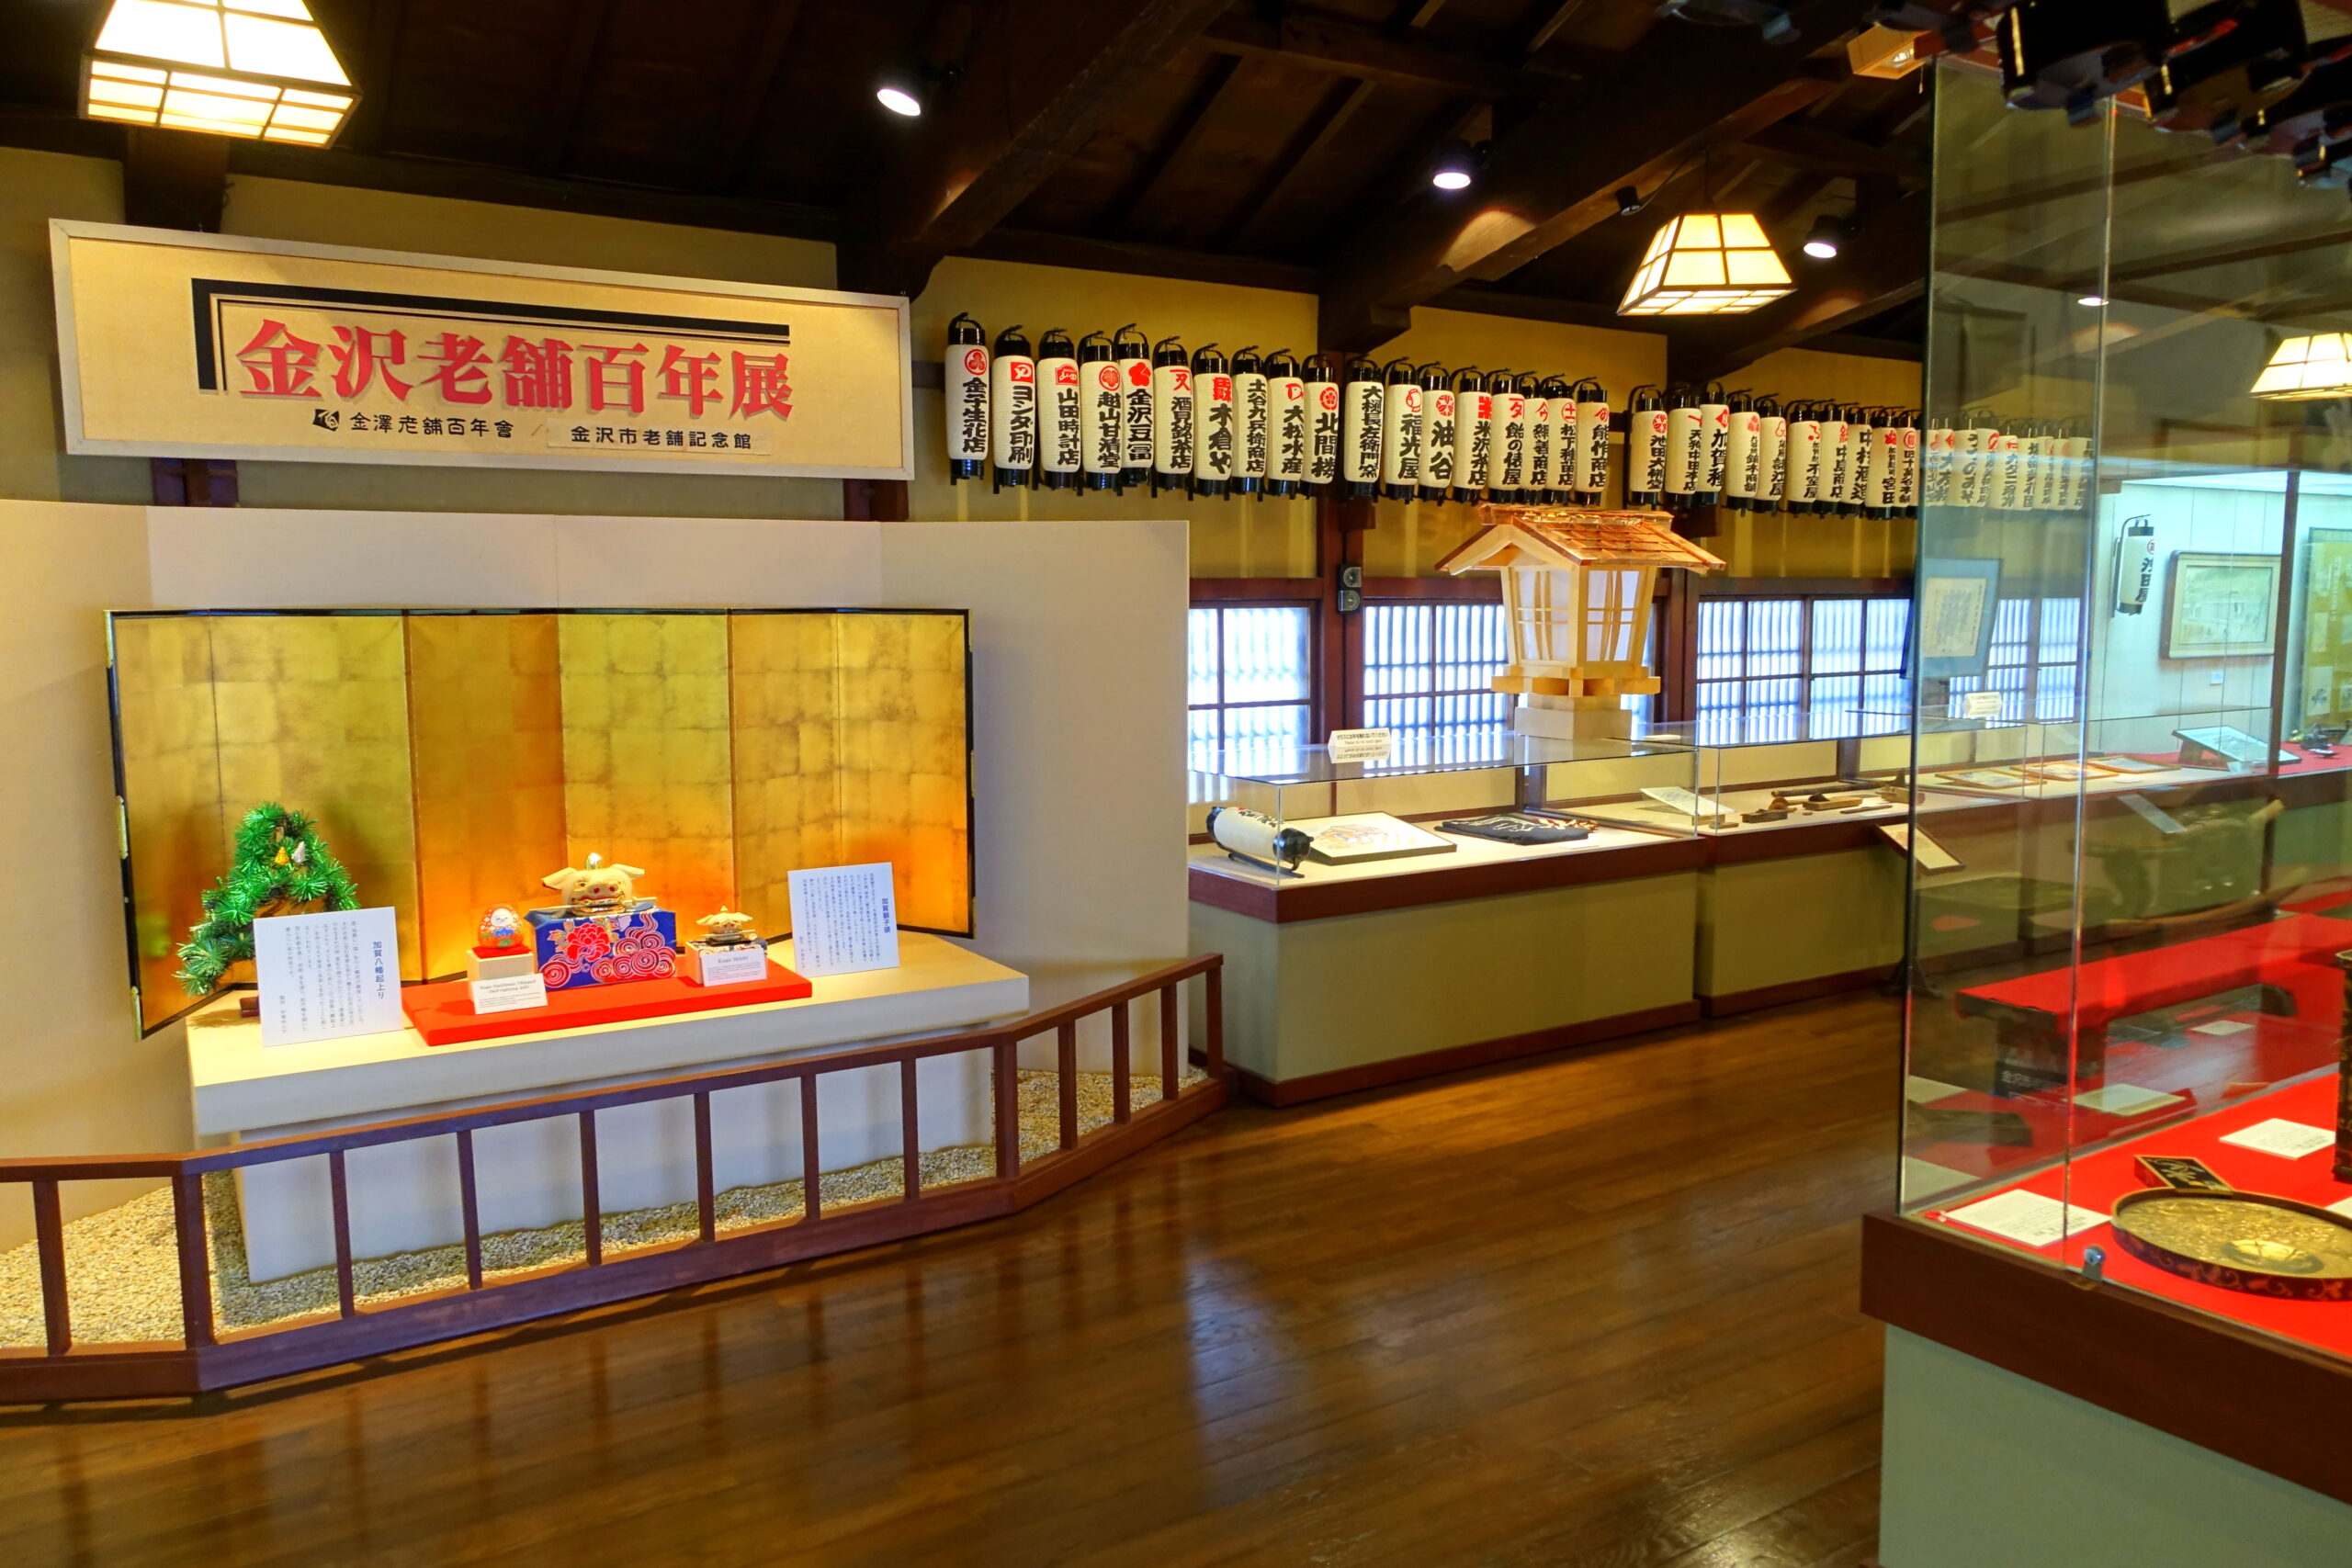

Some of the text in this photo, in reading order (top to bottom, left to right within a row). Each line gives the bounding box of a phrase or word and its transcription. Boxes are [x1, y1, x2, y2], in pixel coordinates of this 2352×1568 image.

[236, 319, 795, 423] 金沢老舗百年展
[350, 412, 514, 440] 金澤老舗百年會
[570, 425, 753, 451] 金沢市老舗記念館
[962, 377, 988, 454] 金子生花店
[1008, 385, 1034, 465] ヨシダ印刷
[1057, 387, 1080, 466] 山田時計店
[1209, 402, 1233, 475] 木倉や
[1281, 404, 1304, 475] 大松水産
[1397, 412, 1422, 479] 福光屋
[1430, 419, 1454, 480] 油谷
